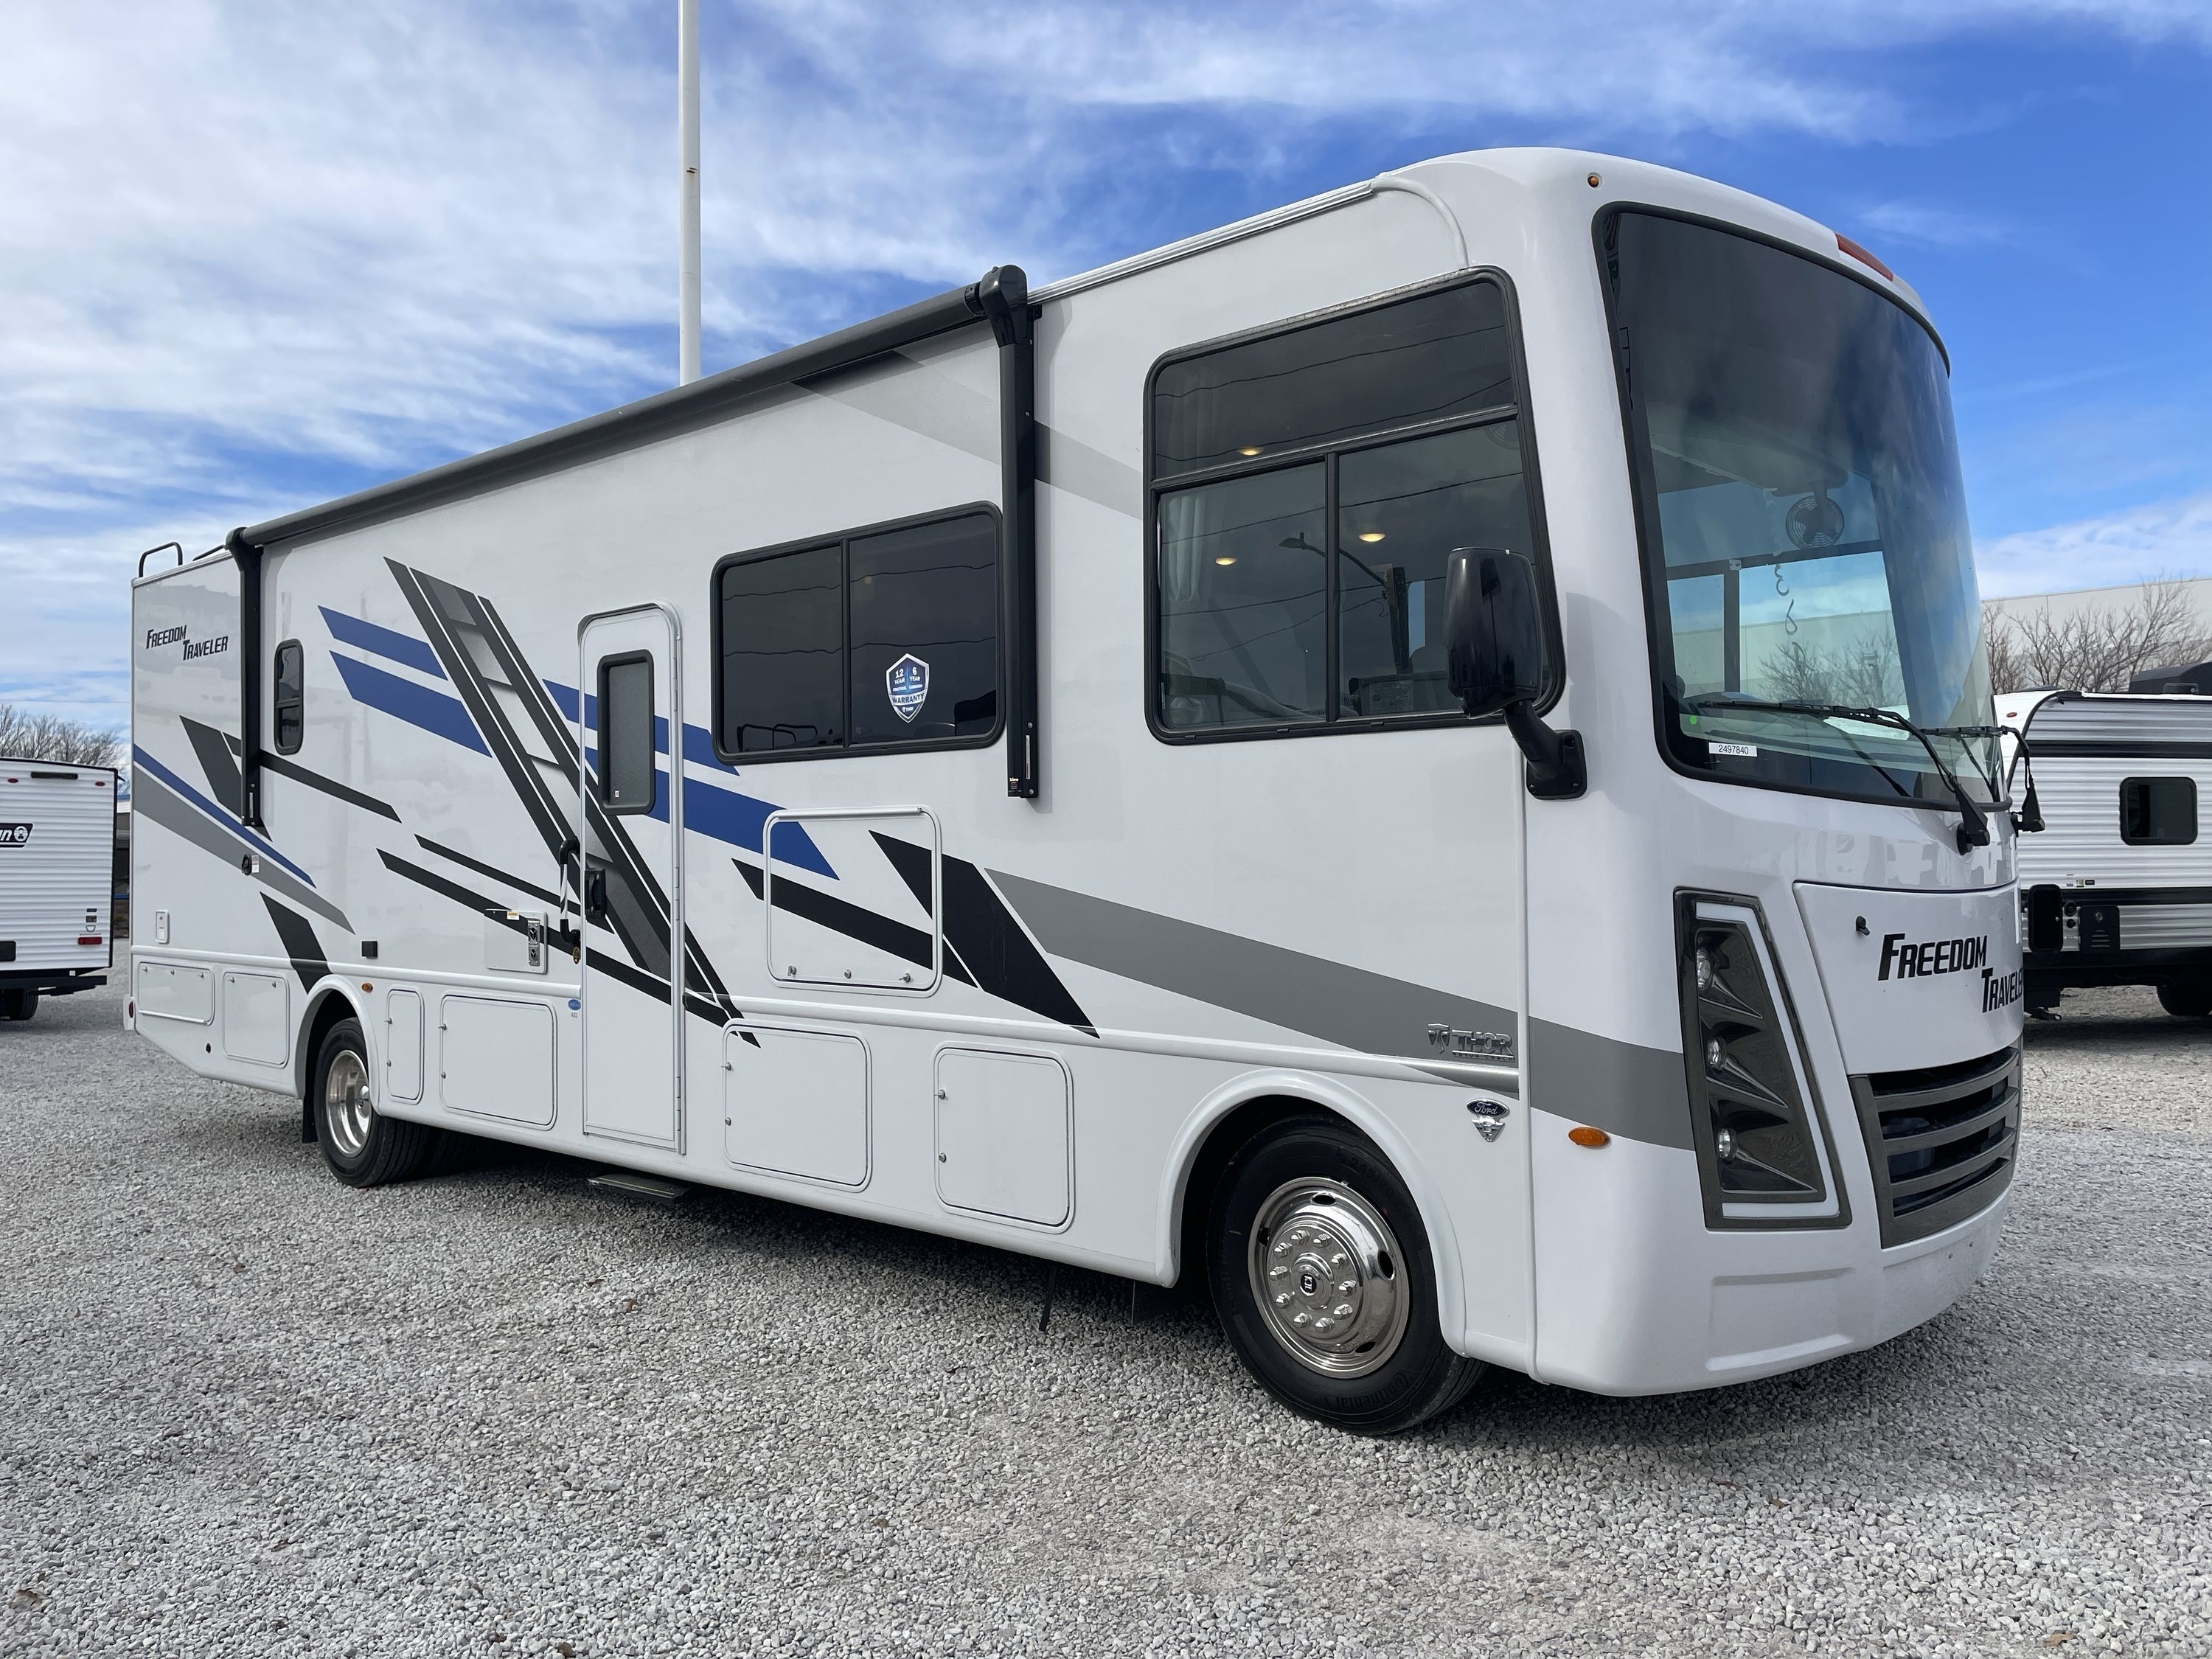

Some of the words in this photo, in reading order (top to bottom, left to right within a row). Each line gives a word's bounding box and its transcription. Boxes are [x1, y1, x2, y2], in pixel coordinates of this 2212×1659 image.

[146, 625, 187, 649] FREEDOM
[183, 636, 229, 661] TRAVELER
[895, 668, 904, 678] 12
[912, 667, 917, 675] 6
[892, 693, 924, 703] WARRANTY
[1718, 745, 1749, 754] 2497840
[1878, 933, 1987, 981] FREEDOM
[1452, 1029, 1514, 1054] THOR
[1474, 1102, 1498, 1115] Ford
